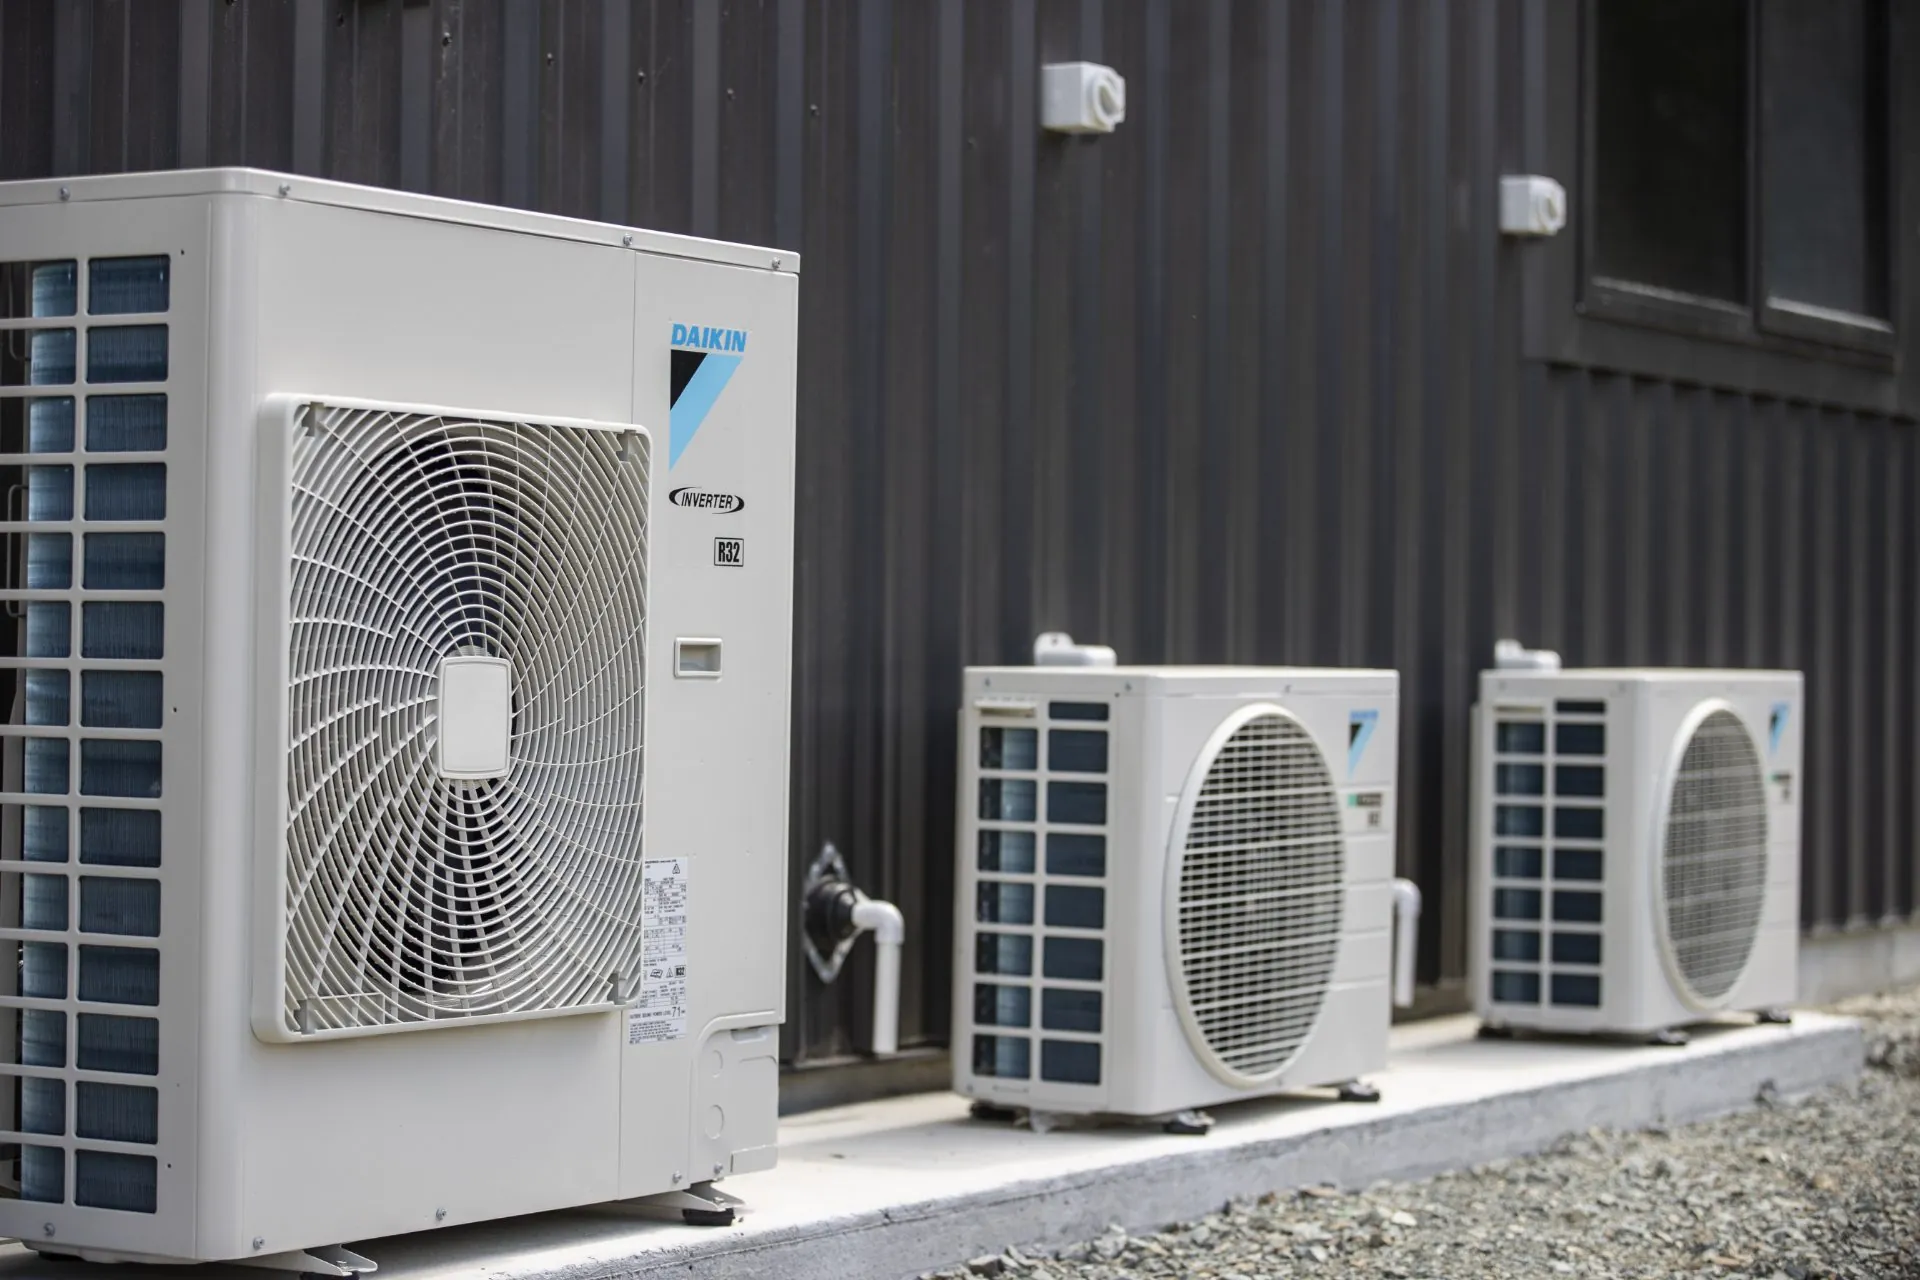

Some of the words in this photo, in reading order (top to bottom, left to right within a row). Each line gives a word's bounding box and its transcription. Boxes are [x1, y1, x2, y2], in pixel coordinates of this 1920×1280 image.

[671, 323, 747, 353] DAIKIN
[681, 491, 733, 510] INVERTER
[718, 541, 740, 563] R32
[672, 1006, 681, 1017] 71
